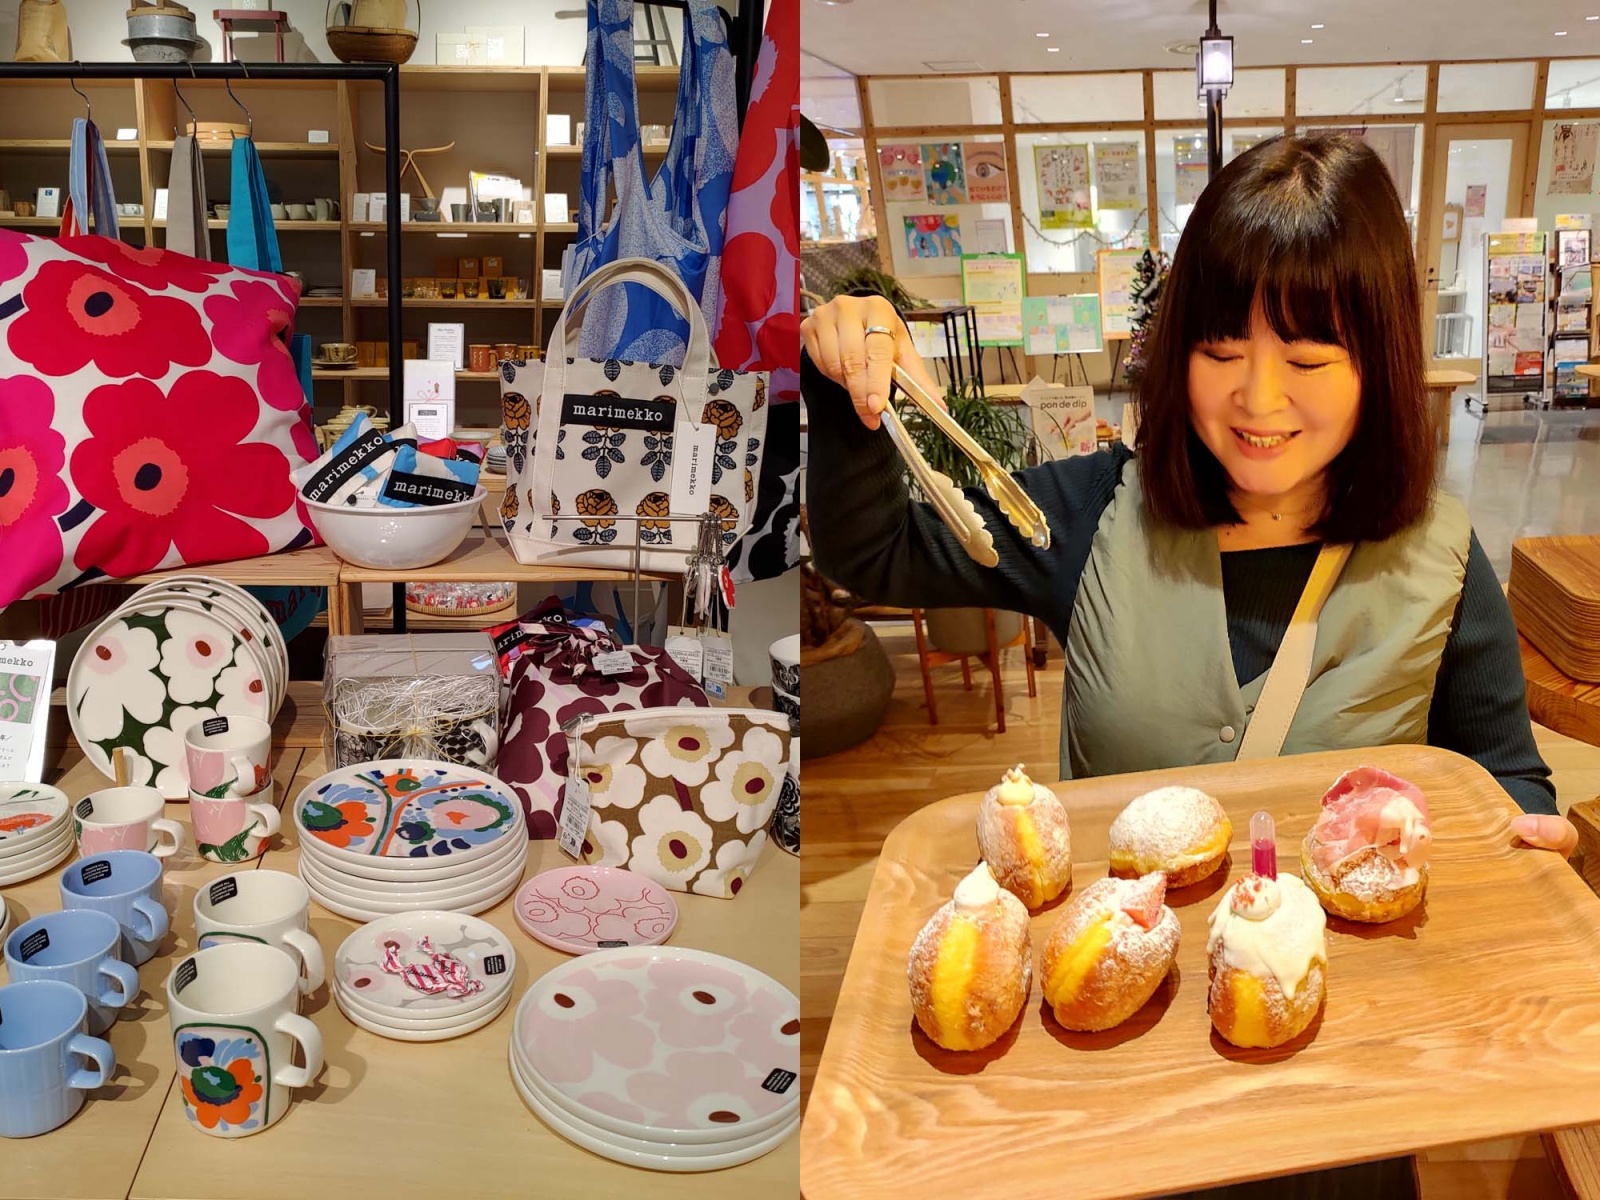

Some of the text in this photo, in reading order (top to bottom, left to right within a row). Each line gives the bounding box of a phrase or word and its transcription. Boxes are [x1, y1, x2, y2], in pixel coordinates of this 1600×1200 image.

[573, 405, 663, 422] marimekko
[1040, 399, 1088, 410] pon de dip
[309, 436, 384, 501] marimekko
[689, 445, 699, 495] marimekko
